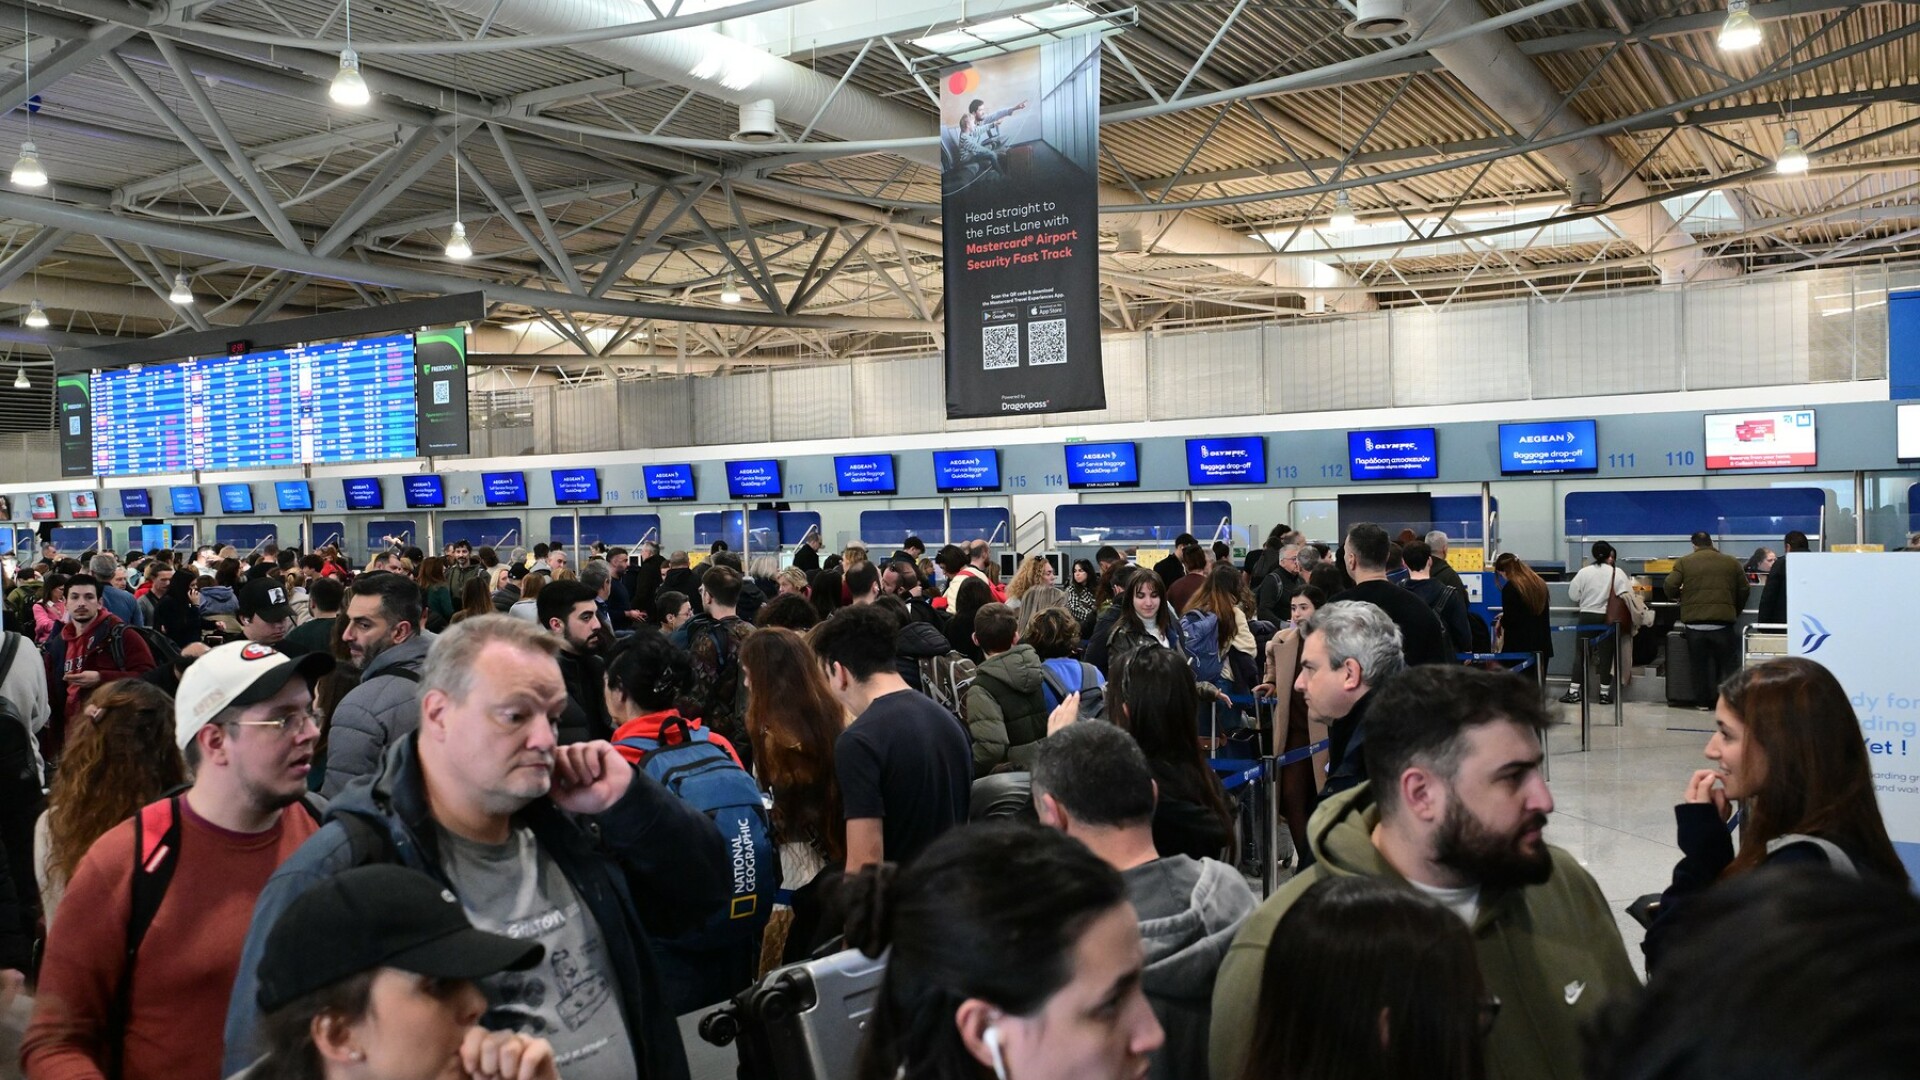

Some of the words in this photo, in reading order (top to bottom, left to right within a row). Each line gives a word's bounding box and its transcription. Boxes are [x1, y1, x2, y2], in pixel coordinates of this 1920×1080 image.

[965, 209, 994, 223] Head
[996, 202, 1040, 219] straight
[1043, 201, 1056, 212] to
[965, 228, 984, 239] the
[986, 223, 1011, 236] Fast
[1013, 219, 1041, 232] Lane
[1043, 213, 1069, 227] with
[966, 234, 1035, 255] Mastercard®
[1036, 229, 1078, 246] Airport
[967, 255, 1011, 271] Security
[1013, 251, 1039, 265] Fast
[1041, 246, 1073, 261] Track
[1002, 401, 1048, 411] Dragonpass
[1519, 434, 1565, 443] AEGEAN
[1513, 450, 1549, 460] Baggage
[1550, 449, 1583, 458] drop-off
[1665, 451, 1694, 466] 110
[1608, 453, 1635, 468] 111
[1200, 463, 1226, 471] Baggage
[1226, 462, 1252, 470] drop-off
[1321, 464, 1343, 477] 112
[1276, 466, 1298, 479] 113
[1008, 476, 1026, 487] 115
[1044, 475, 1063, 486] 114
[789, 484, 804, 495] 117
[819, 483, 834, 494] 116
[450, 495, 461, 505] 121
[473, 495, 484, 505] 120
[605, 490, 619, 501] 119
[631, 490, 645, 501] 118
[1861, 715, 1917, 738] ding
[1896, 785, 1920, 795] wait
[737, 817, 757, 893] GEOGRAPHIC
[731, 834, 746, 894] NATIONAL
